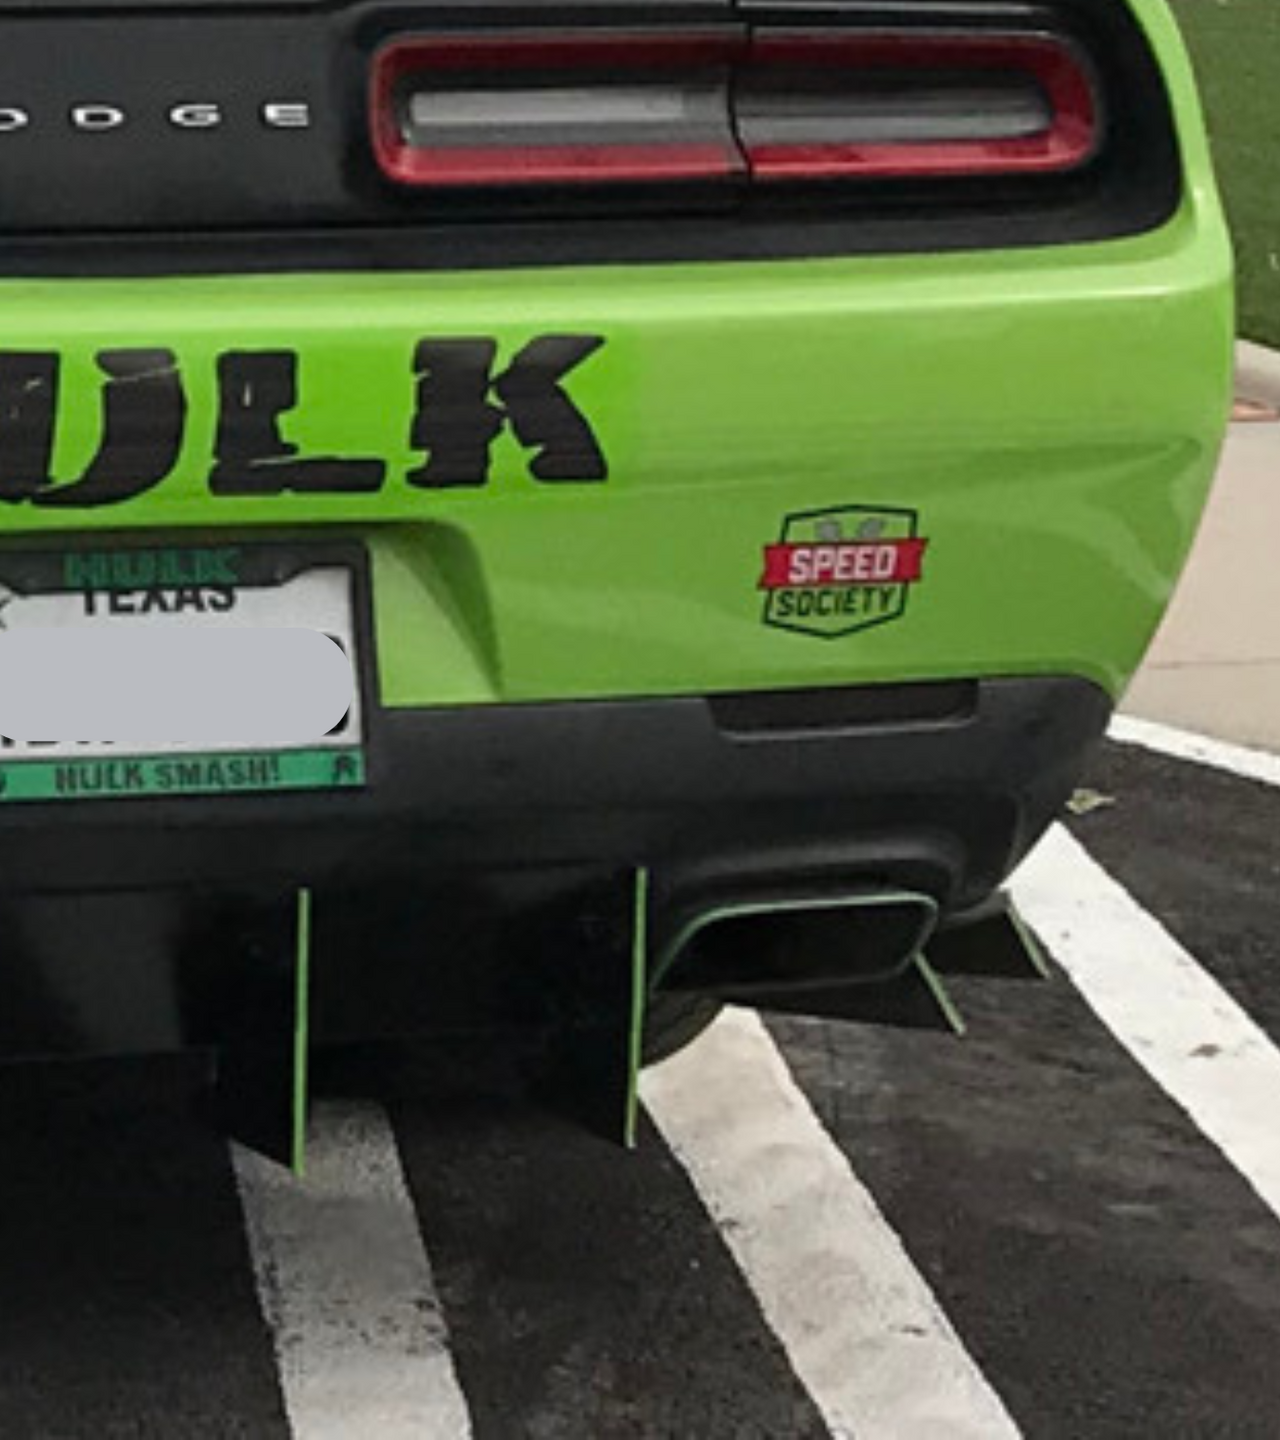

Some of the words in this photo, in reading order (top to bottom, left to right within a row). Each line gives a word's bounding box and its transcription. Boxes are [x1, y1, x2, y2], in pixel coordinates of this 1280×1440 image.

[64, 548, 238, 587] HULK
[787, 544, 899, 585] SPEED
[83, 582, 238, 616] TEXAS
[776, 587, 897, 617] SOCIETY
[55, 765, 146, 794] HULK
[154, 758, 282, 791] SMASH!
